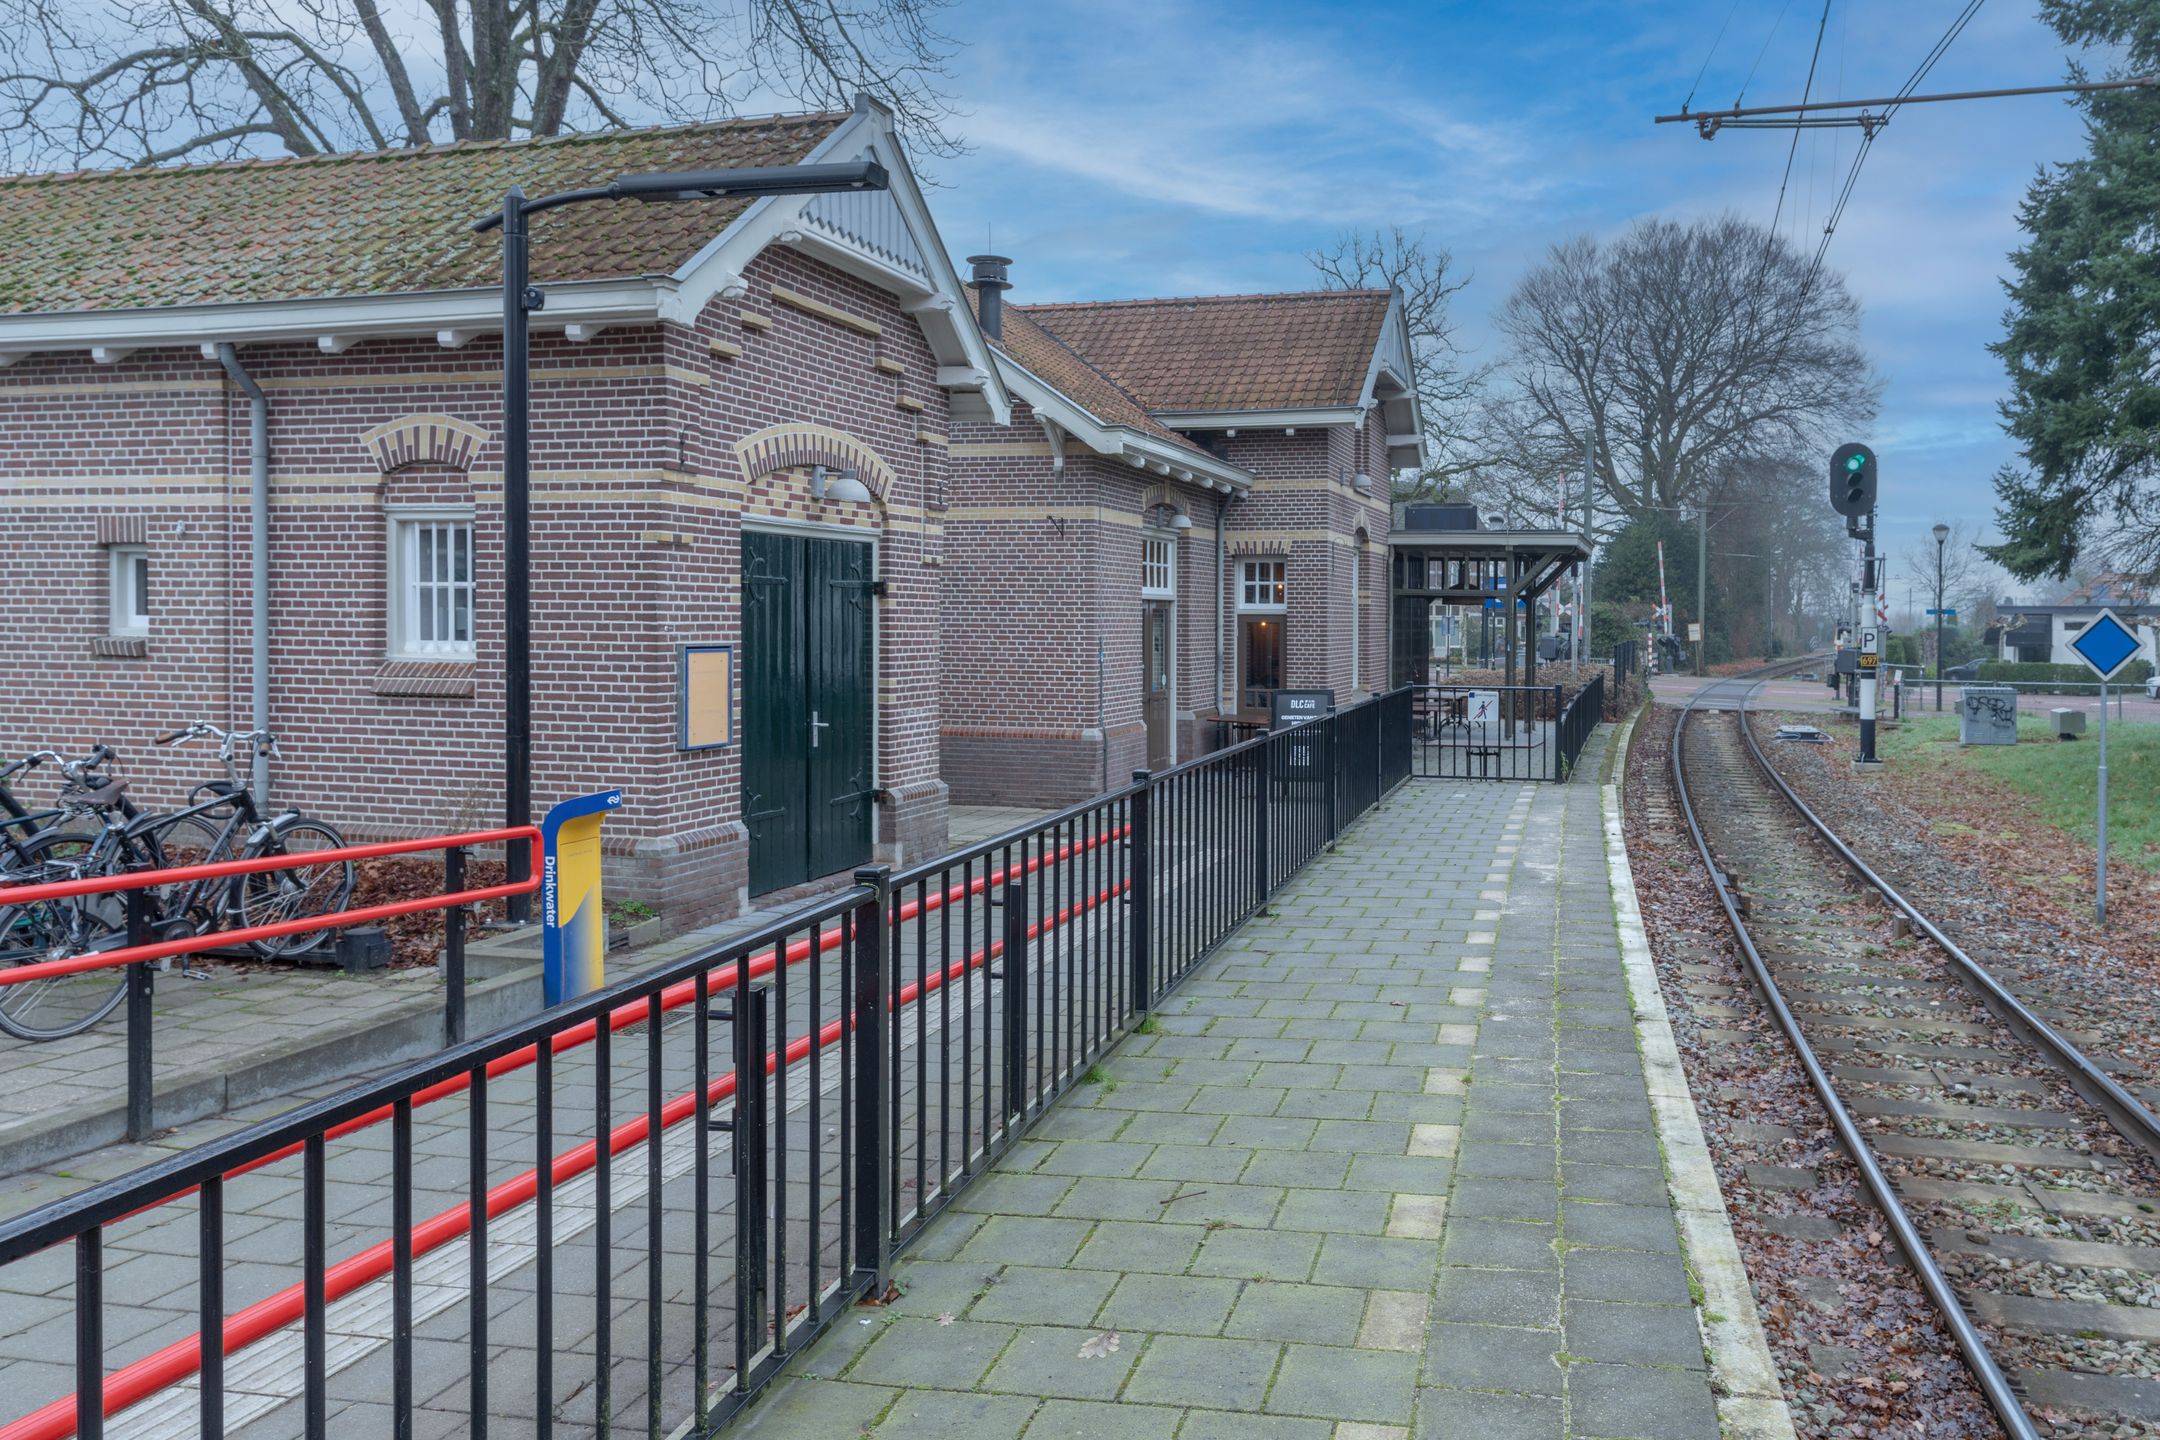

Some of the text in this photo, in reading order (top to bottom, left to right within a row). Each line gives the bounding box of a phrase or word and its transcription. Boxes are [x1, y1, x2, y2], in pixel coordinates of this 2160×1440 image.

[1864, 633, 1875, 648] P
[1862, 656, 1877, 665] 697
[1291, 700, 1304, 709] DLC
[545, 856, 557, 928] Drinkwater
